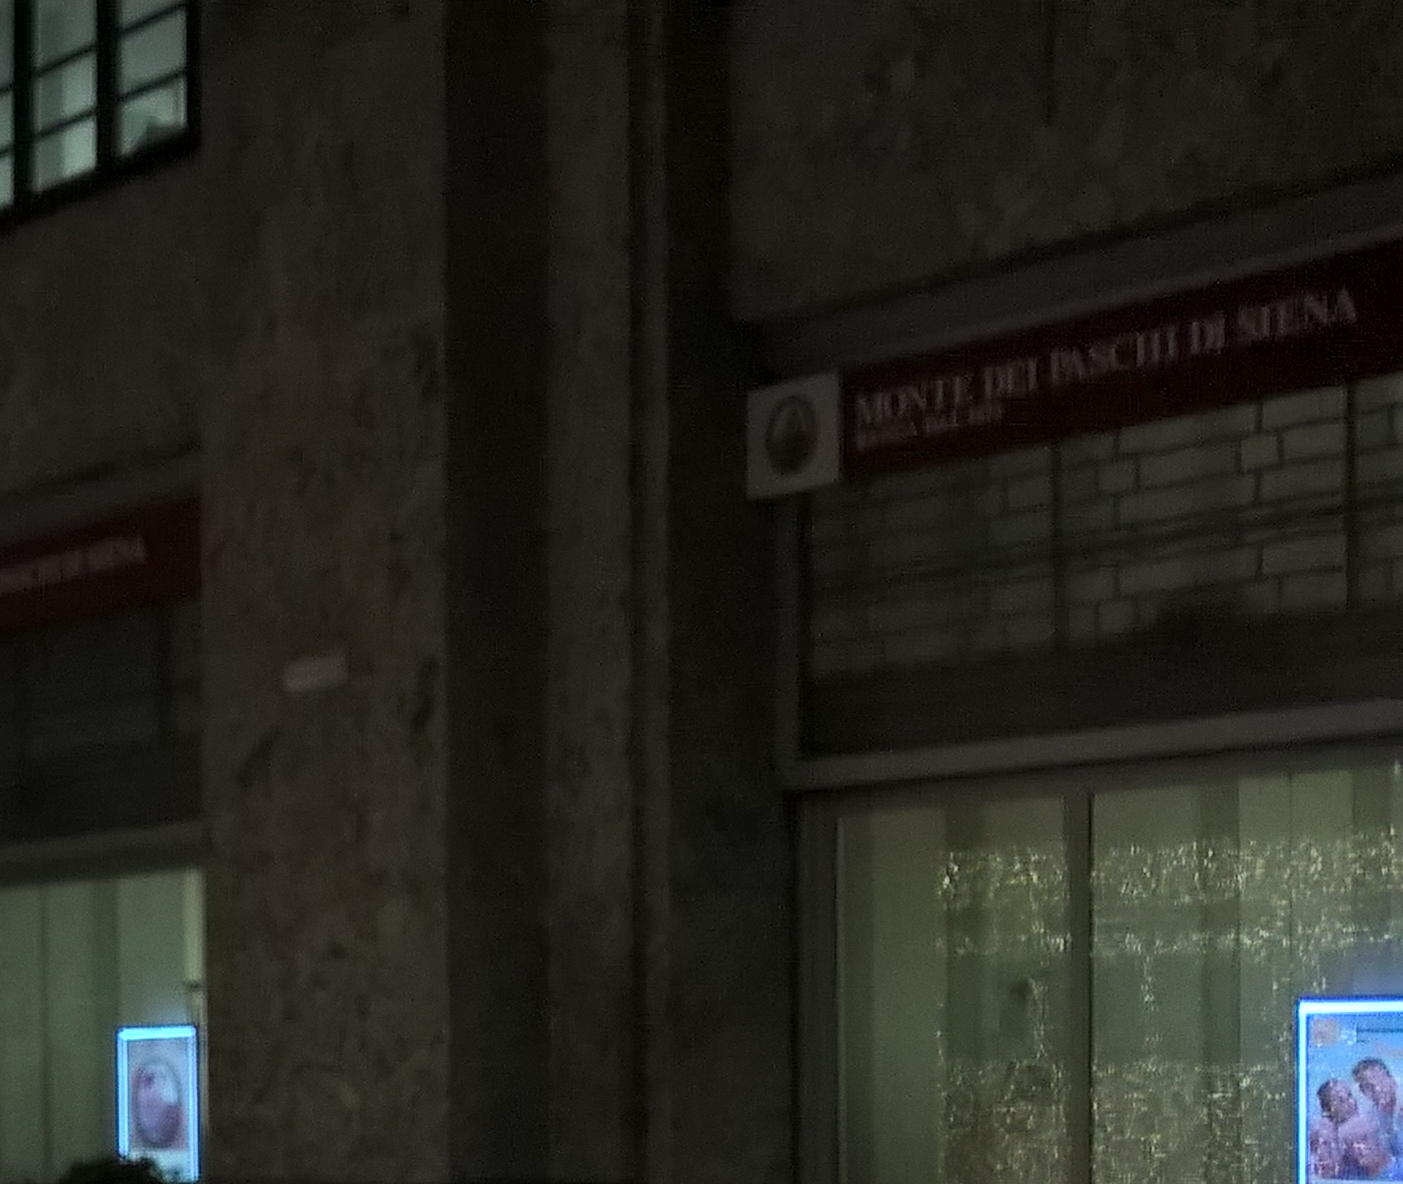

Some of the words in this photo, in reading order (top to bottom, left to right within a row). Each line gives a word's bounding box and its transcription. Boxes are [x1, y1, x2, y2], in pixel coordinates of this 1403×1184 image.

[854, 372, 974, 427] MONTE
[983, 357, 1040, 400] DEI
[1049, 323, 1181, 386] PASCHI
[1190, 313, 1226, 354] DI
[1236, 287, 1361, 343] SIENA
